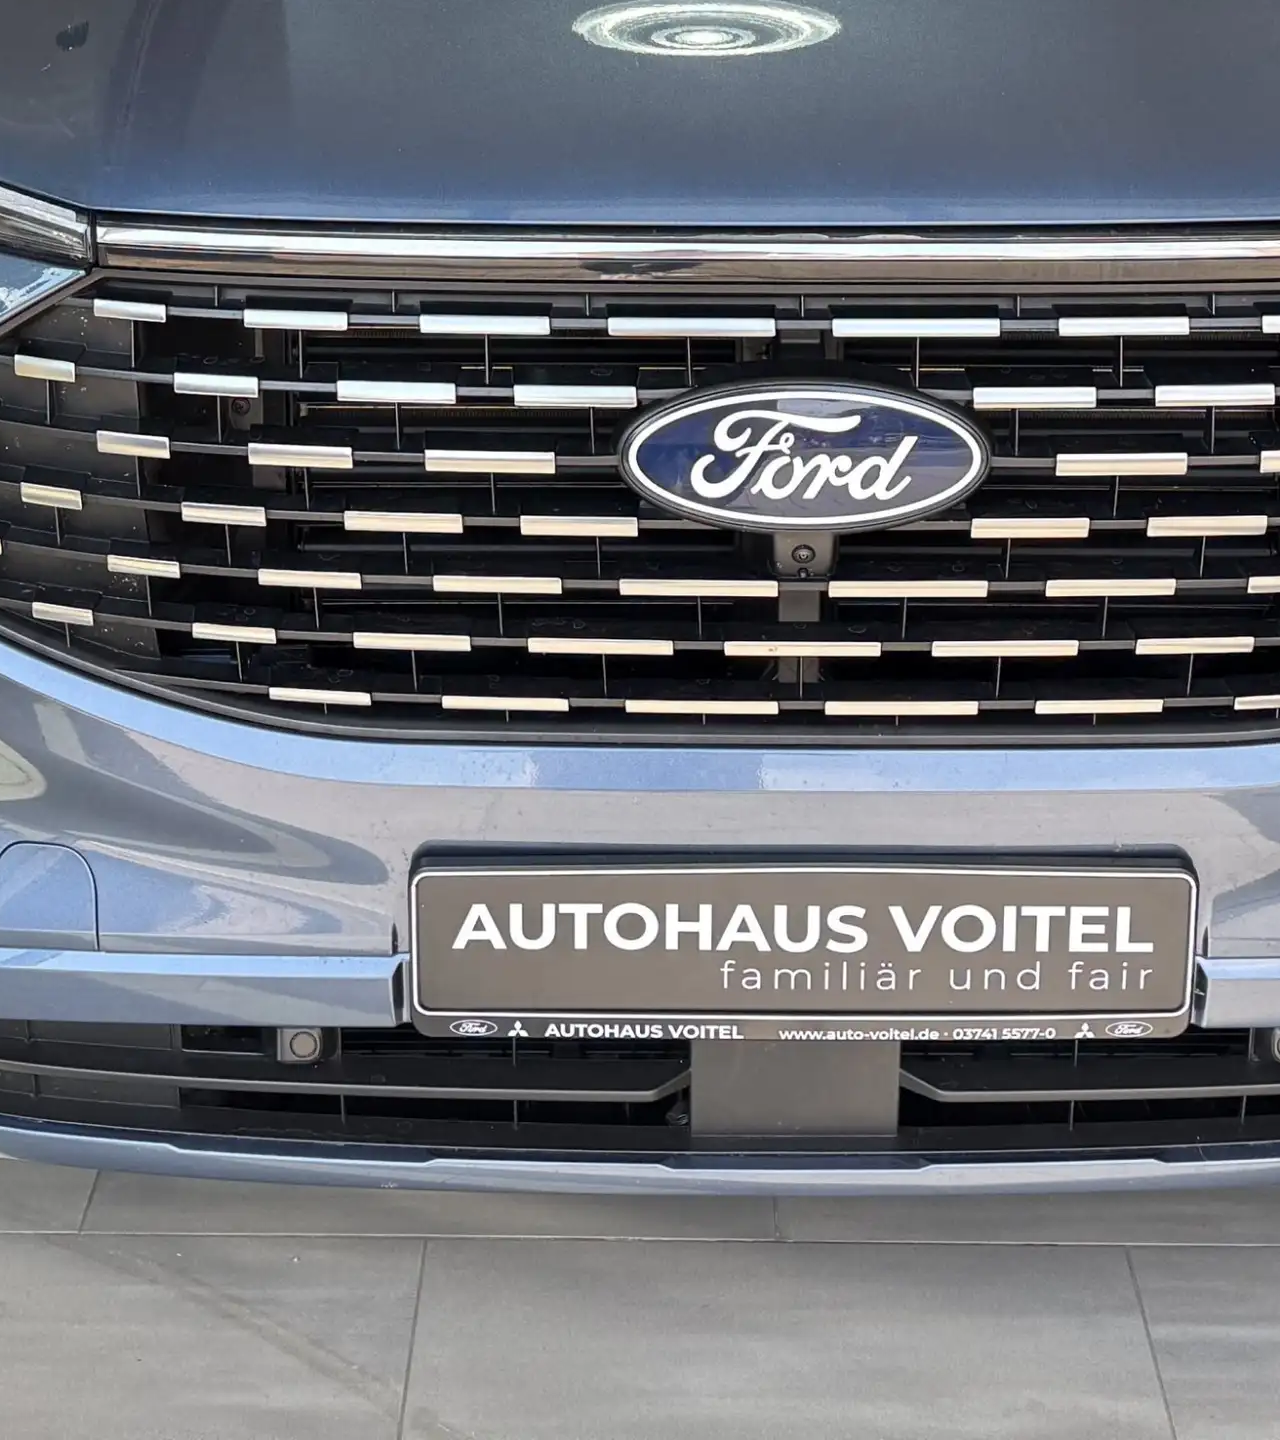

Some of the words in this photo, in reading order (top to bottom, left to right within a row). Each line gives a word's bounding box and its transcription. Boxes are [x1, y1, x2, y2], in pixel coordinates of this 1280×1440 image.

[690, 409, 919, 501] Ford
[451, 902, 869, 954] AUTOHAUS
[887, 904, 1154, 954] VOITEL
[719, 959, 923, 992] familiär
[948, 960, 1041, 991] und
[1066, 960, 1154, 991] fair
[544, 1023, 664, 1040] AUTOHAUS
[667, 1024, 745, 1041] VOITEL
[778, 1027, 940, 1041] www.auto-voitel.de
[952, 1027, 998, 1041] 03741
[1001, 1027, 1057, 1040] 5577-0
